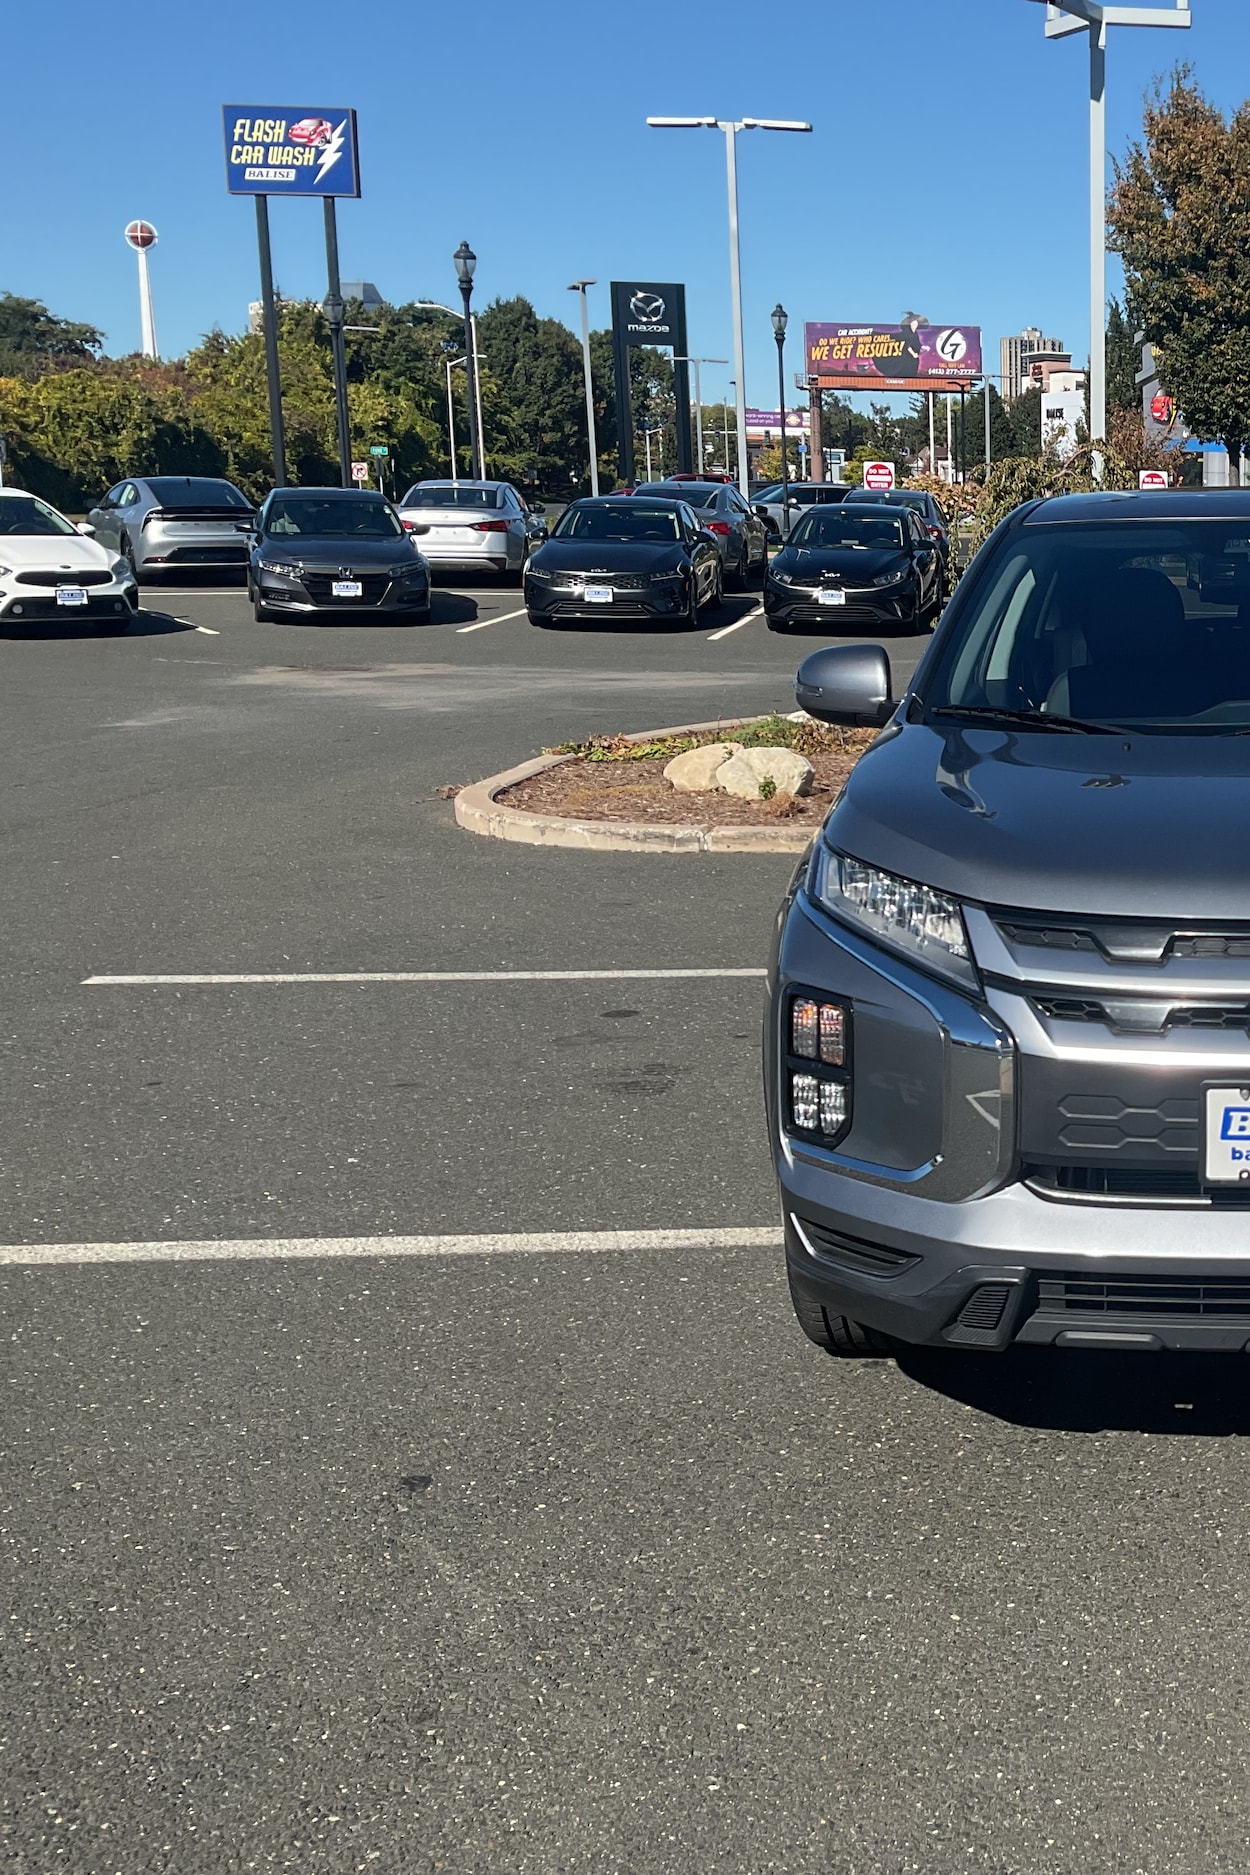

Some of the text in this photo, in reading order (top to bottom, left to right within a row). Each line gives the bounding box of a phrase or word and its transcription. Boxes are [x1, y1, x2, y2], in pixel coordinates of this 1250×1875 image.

[233, 118, 286, 143] FLASH
[230, 145, 315, 166] CAR WASH
[247, 170, 294, 179] BALISE
[819, 338, 828, 346] DO
[829, 337, 838, 345] WE
[858, 335, 872, 343] WHO
[811, 341, 906, 361] WE GET RESULTS!
